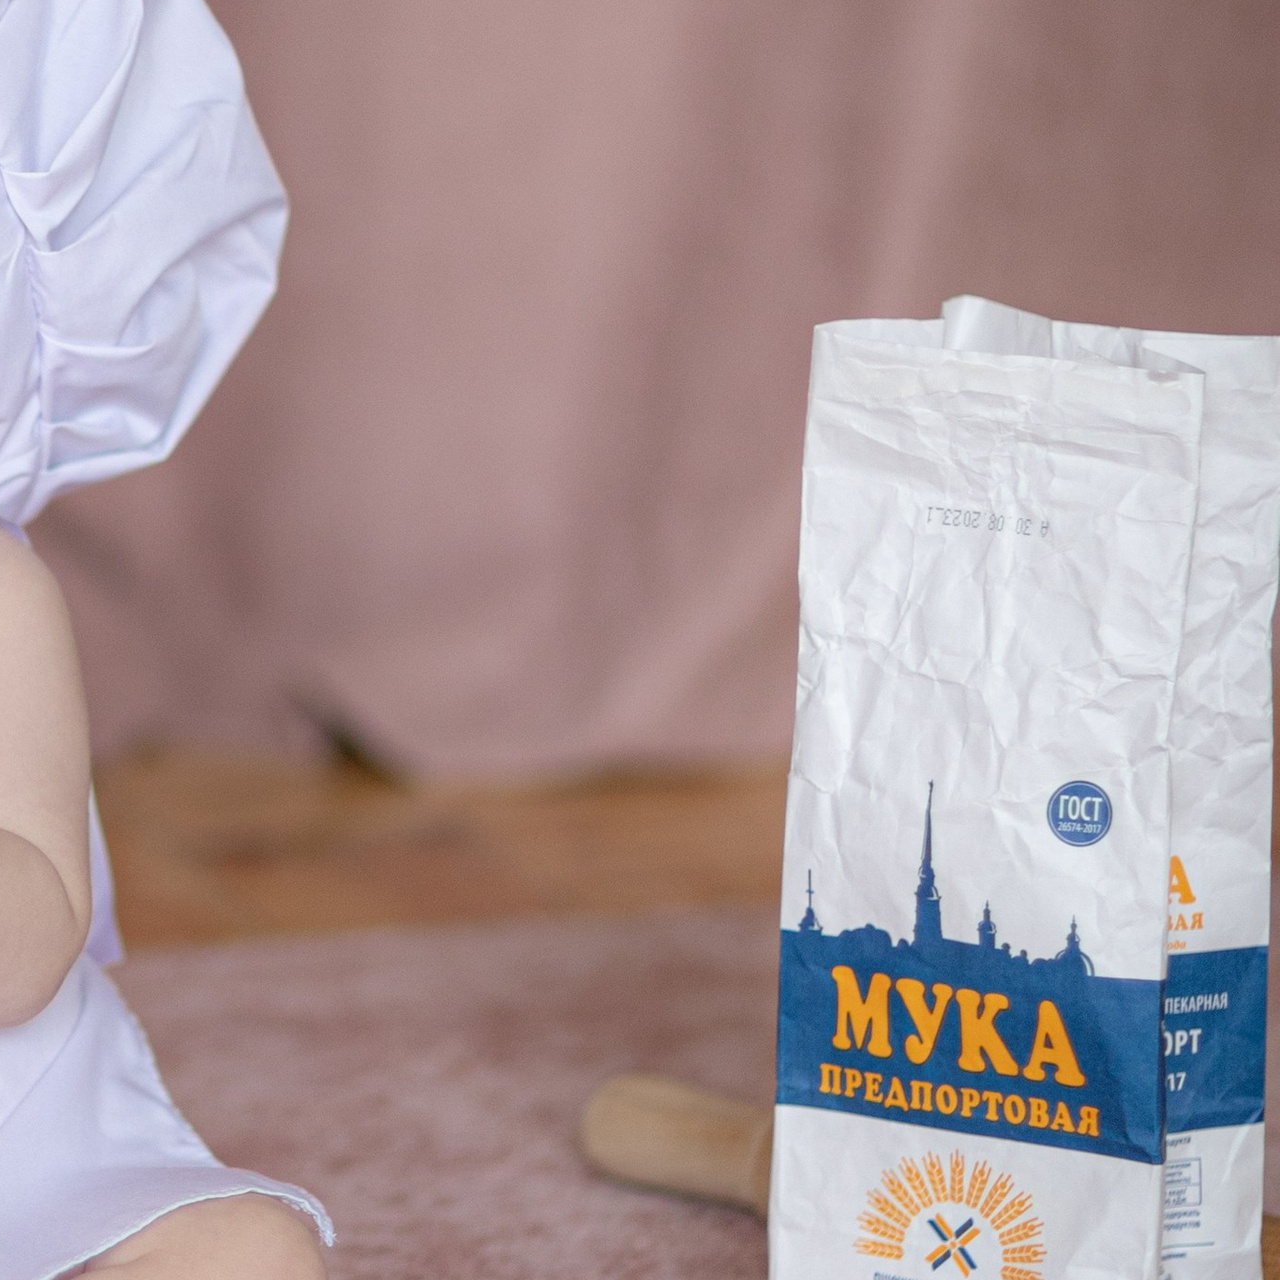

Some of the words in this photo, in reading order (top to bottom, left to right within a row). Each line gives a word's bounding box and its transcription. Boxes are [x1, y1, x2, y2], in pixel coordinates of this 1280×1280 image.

[1057, 821, 1102, 834] 26574-2017
[1058, 795, 1103, 822] ГОСТ
[831, 964, 1086, 1088] МУКА
[819, 1063, 1100, 1138] ПРЕДПОРТОВАЯ
